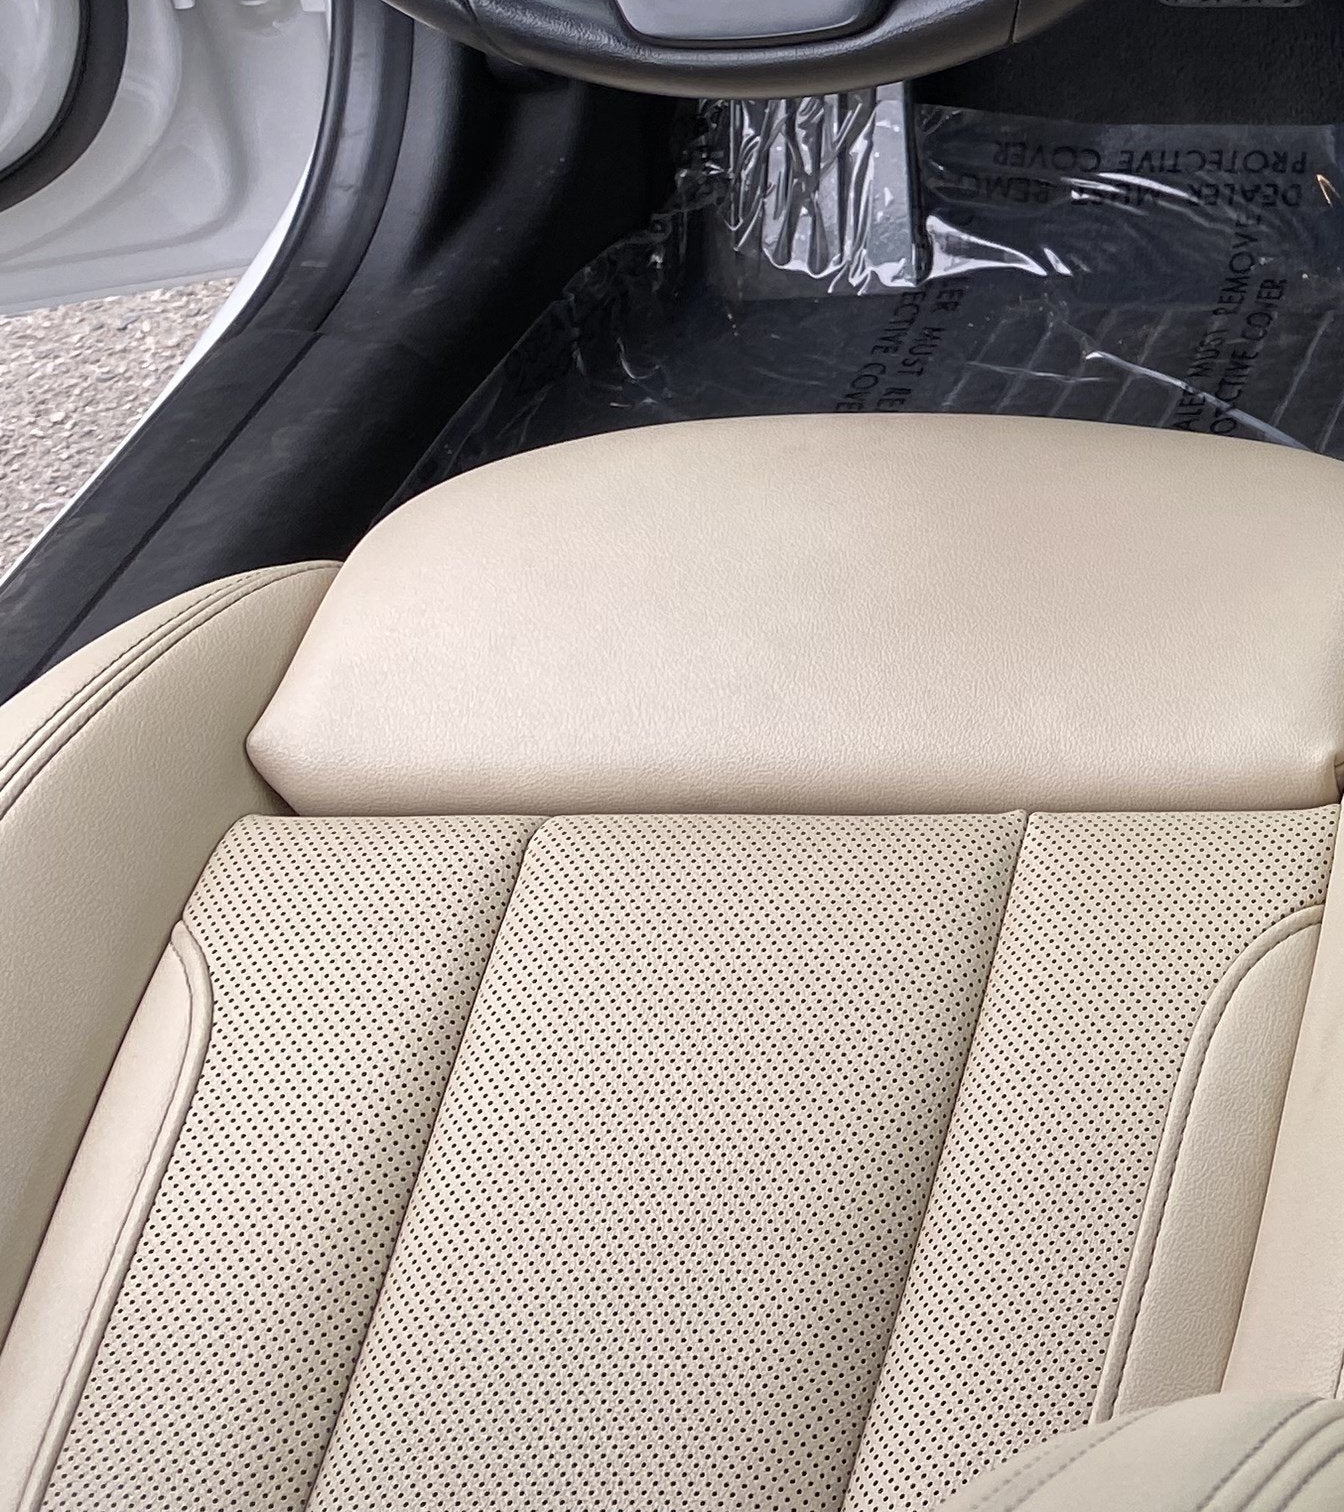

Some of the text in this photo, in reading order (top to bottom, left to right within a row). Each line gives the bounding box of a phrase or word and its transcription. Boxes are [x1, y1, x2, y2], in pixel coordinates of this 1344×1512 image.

[995, 141, 1307, 175] PROTECTIVE COVER
[1188, 181, 1301, 208] DEALER
[835, 361, 887, 411] COVE
